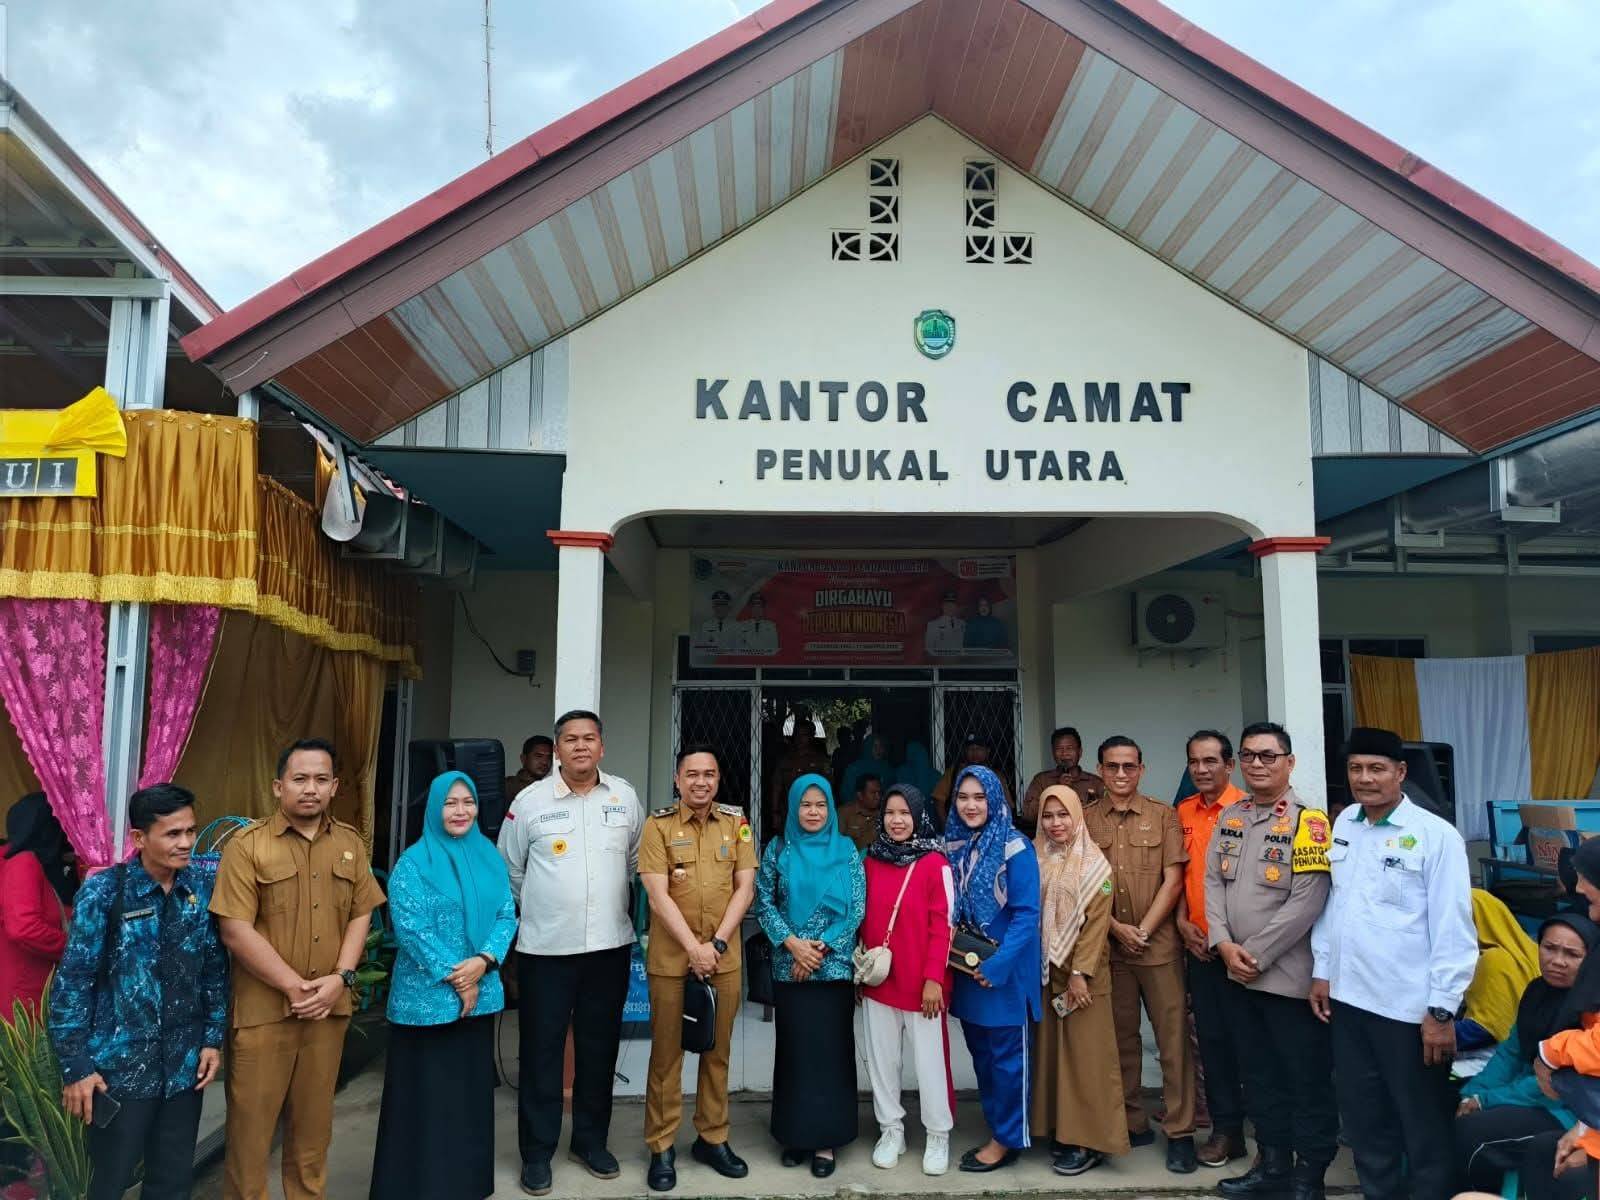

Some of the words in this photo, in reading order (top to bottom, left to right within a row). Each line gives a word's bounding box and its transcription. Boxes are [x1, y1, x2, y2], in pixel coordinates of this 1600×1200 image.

[696, 379, 928, 422] KANTOR
[1007, 381, 1191, 422] CAMAT
[756, 449, 949, 480] PENUKAL
[985, 449, 1124, 481] UTARA
[815, 590, 893, 606] DIRGAHAYU
[1264, 834, 1291, 844] POLRI
